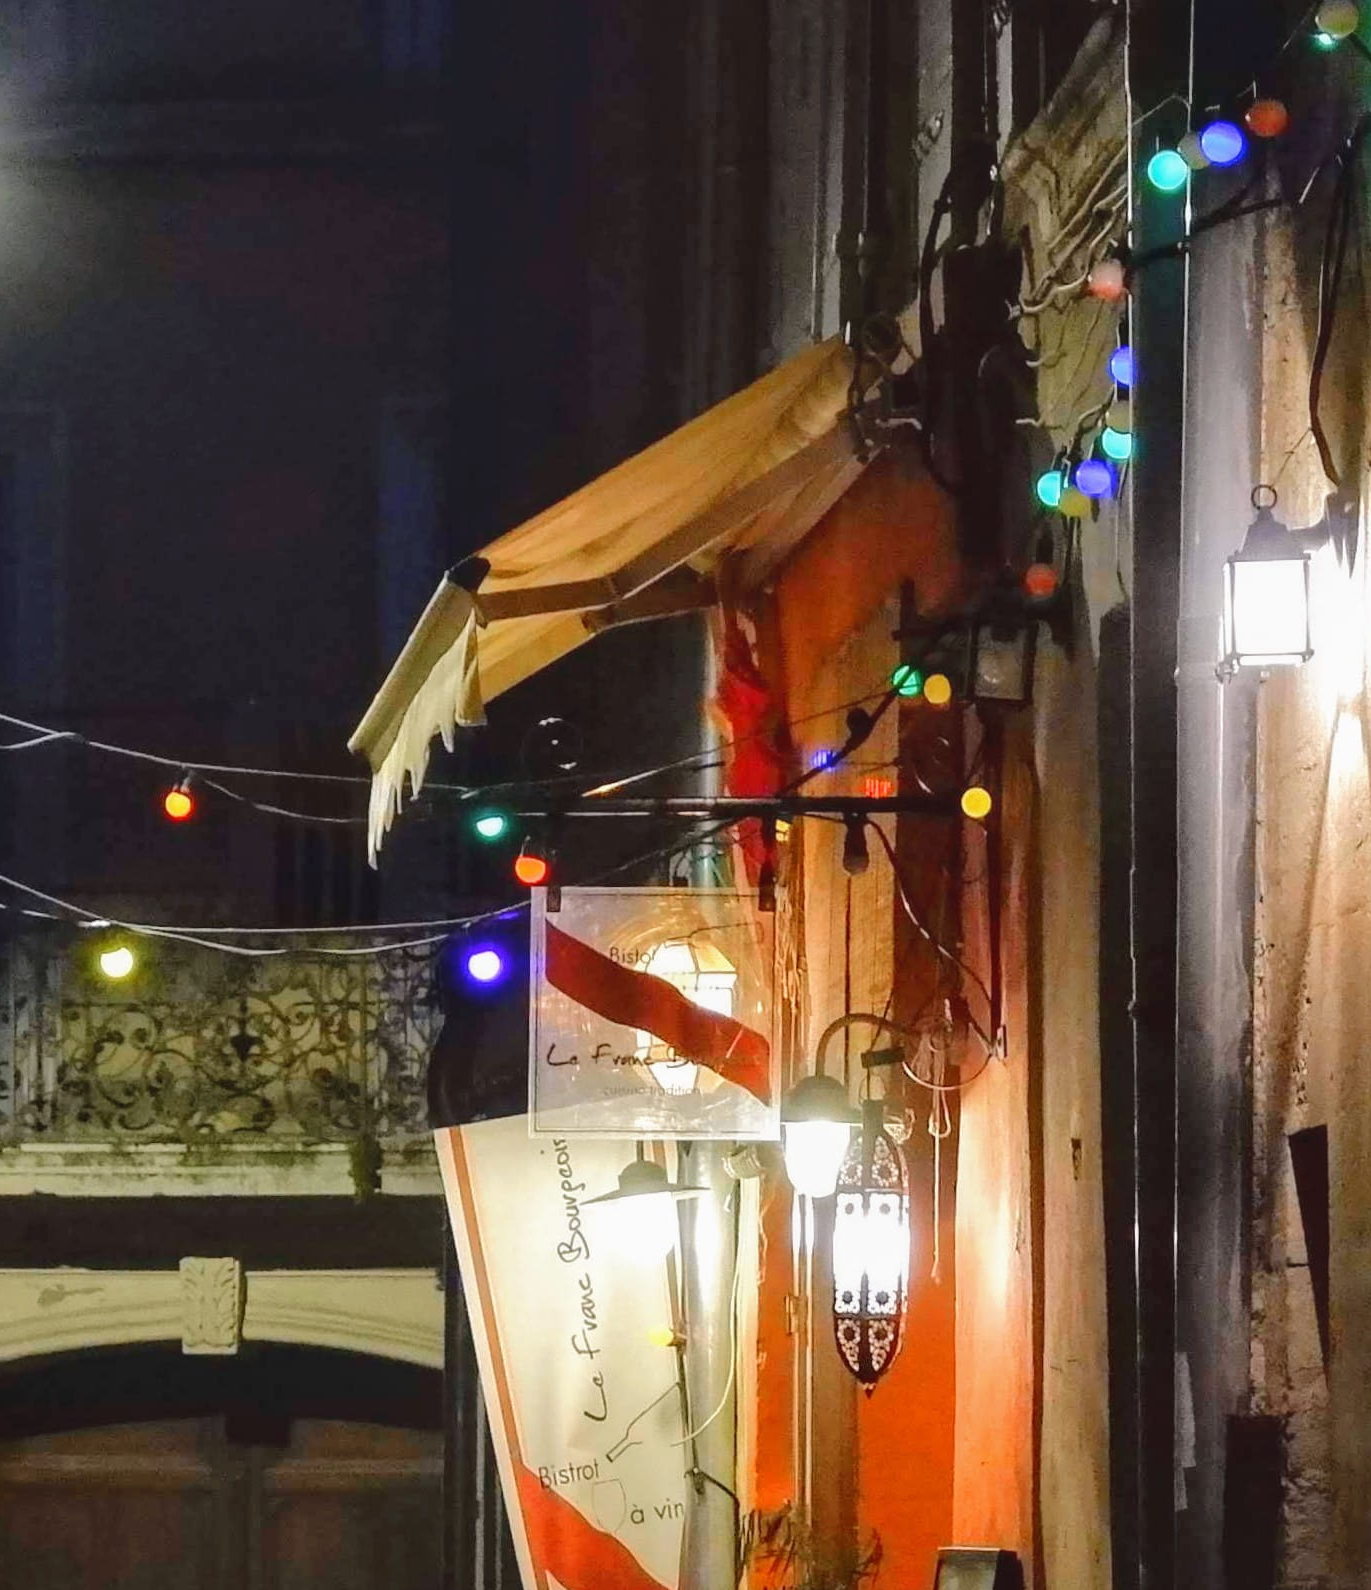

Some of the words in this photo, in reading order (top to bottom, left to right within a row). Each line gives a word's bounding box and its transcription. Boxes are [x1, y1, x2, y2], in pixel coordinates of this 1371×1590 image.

[546, 1042, 579, 1068] Le
[591, 1043, 655, 1067] Franc
[540, 1138, 590, 1263] Bourgeois
[570, 1272, 598, 1361] Franc
[583, 1374, 608, 1422] Le
[538, 1461, 599, 1491] Bistrot
[630, 1501, 645, 1526] à
[653, 1499, 684, 1522] vin
